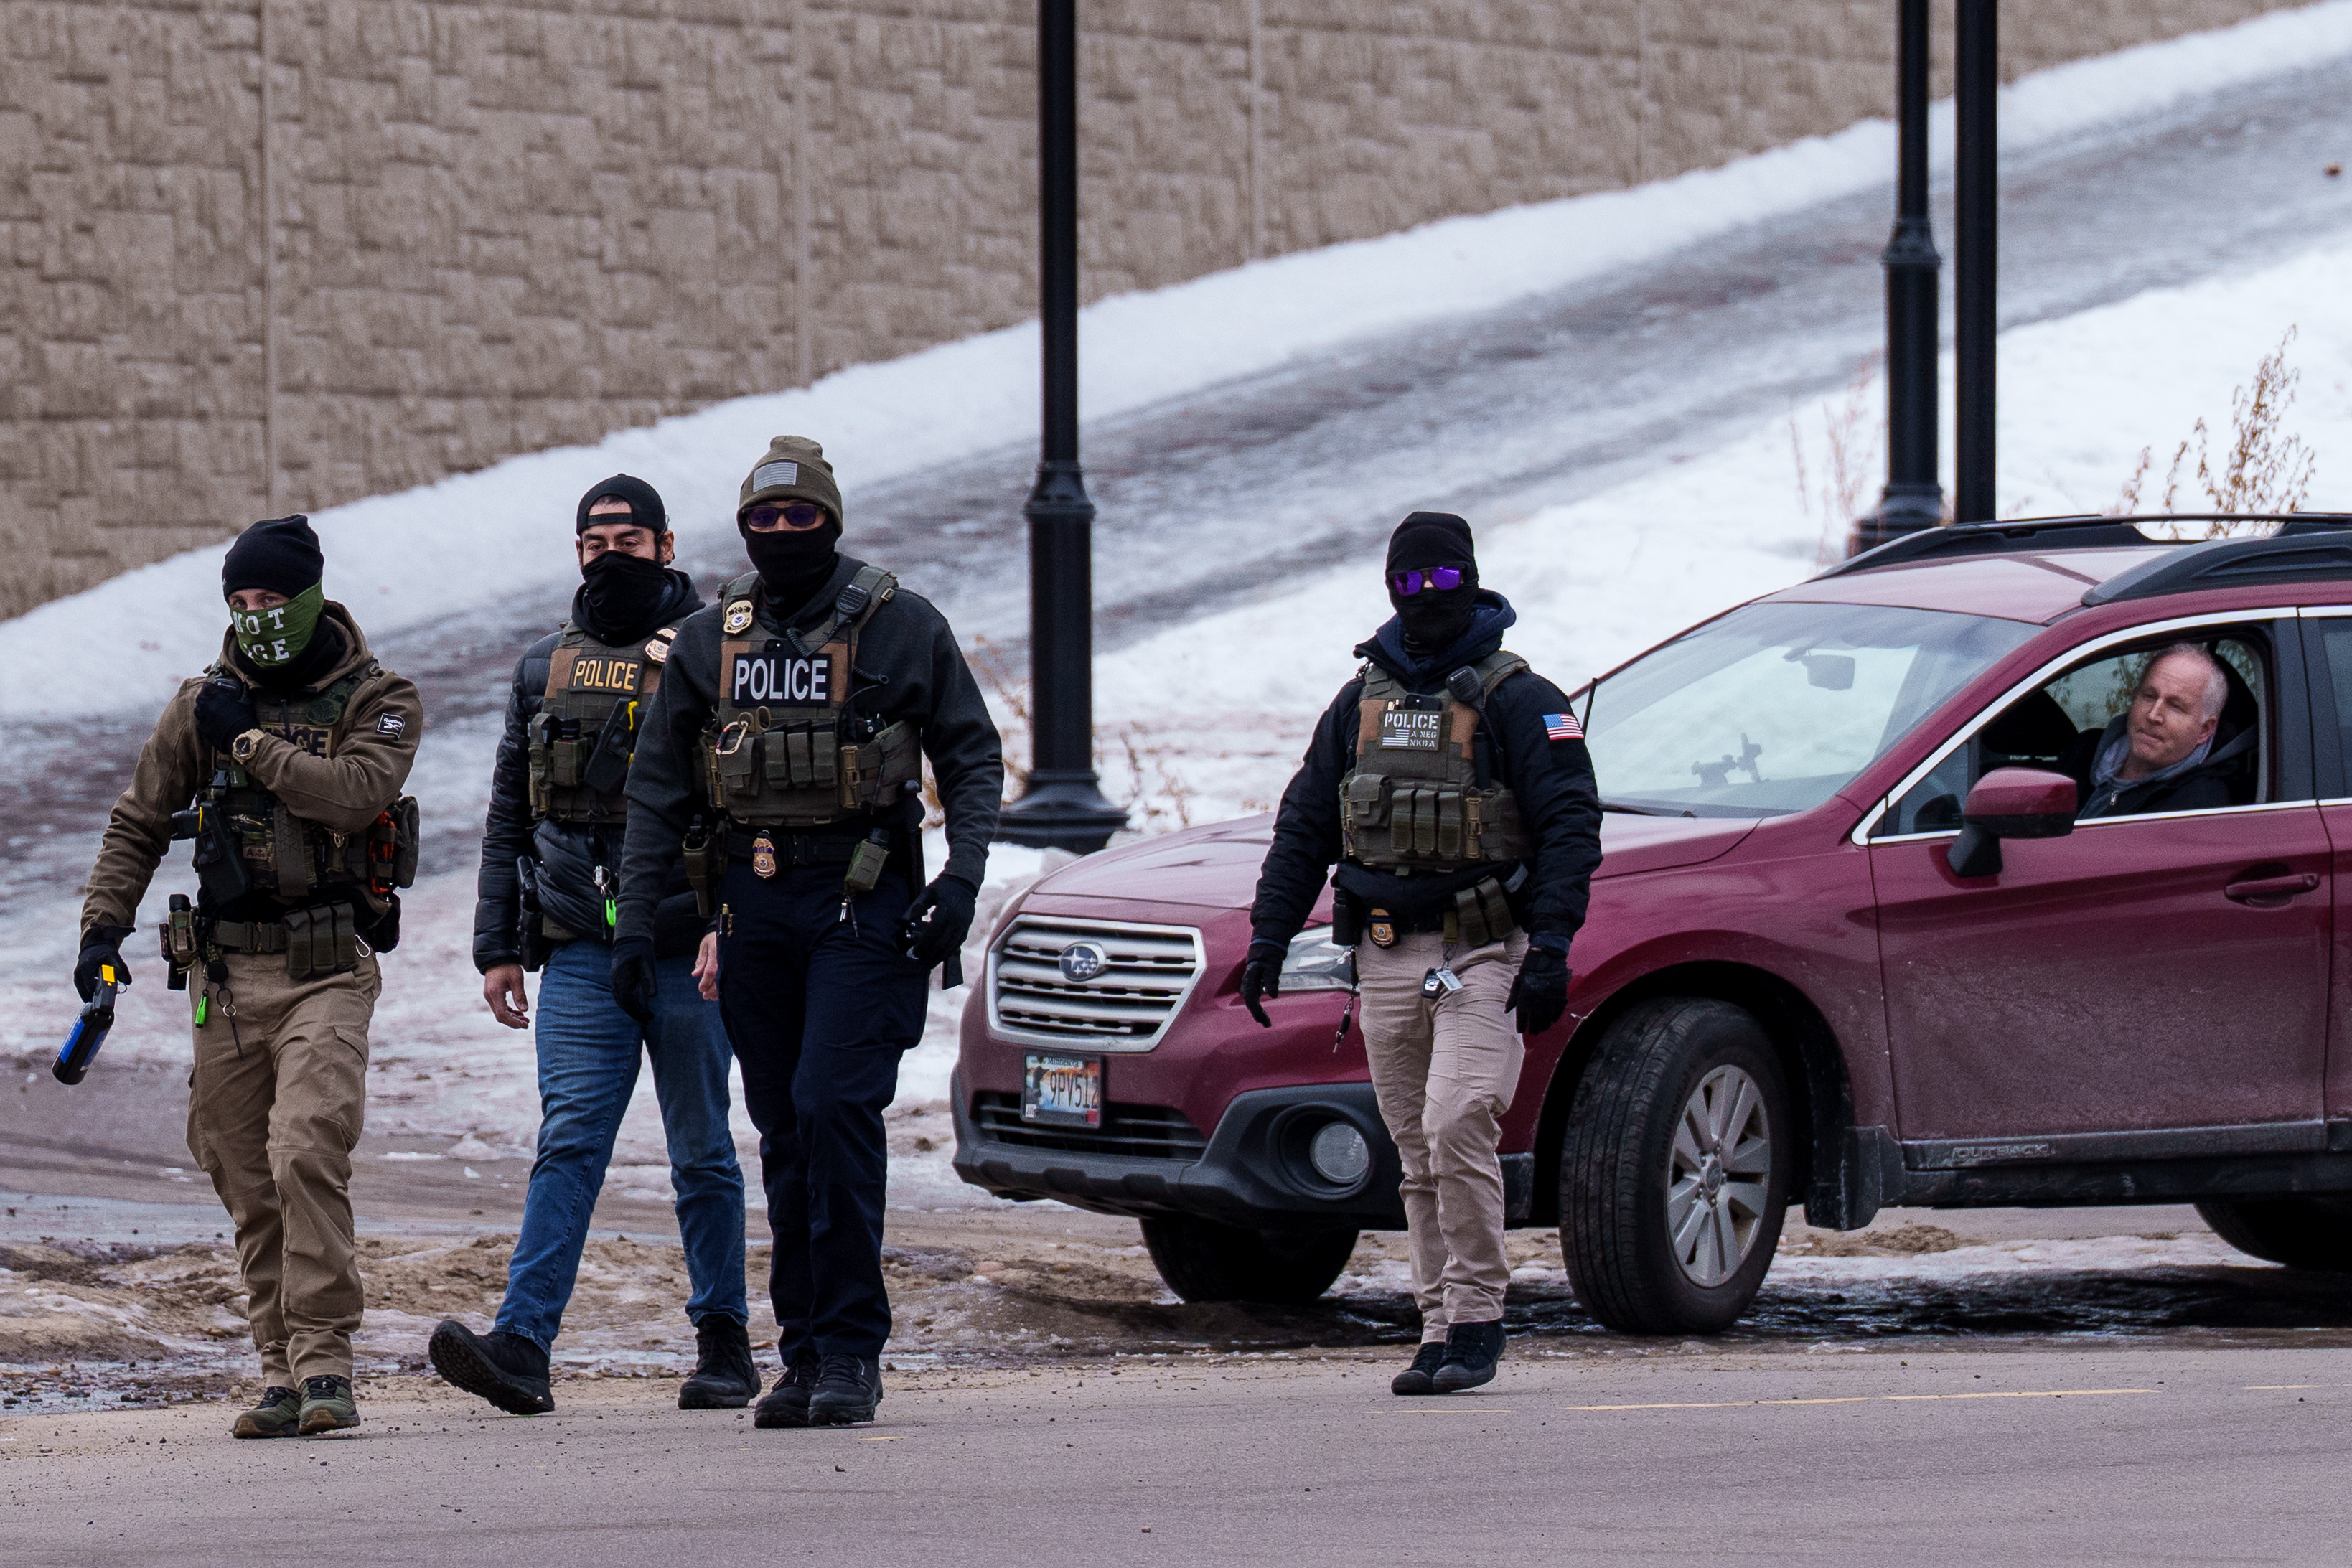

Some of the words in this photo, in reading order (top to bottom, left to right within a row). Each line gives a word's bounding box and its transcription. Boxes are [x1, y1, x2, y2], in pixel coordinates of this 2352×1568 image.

[233, 607, 284, 635] NOT
[573, 659, 638, 690] POLICE
[734, 659, 828, 700] POLICE
[1384, 713, 1439, 729] POLICE
[1050, 1071, 1099, 1109] 9PV512
